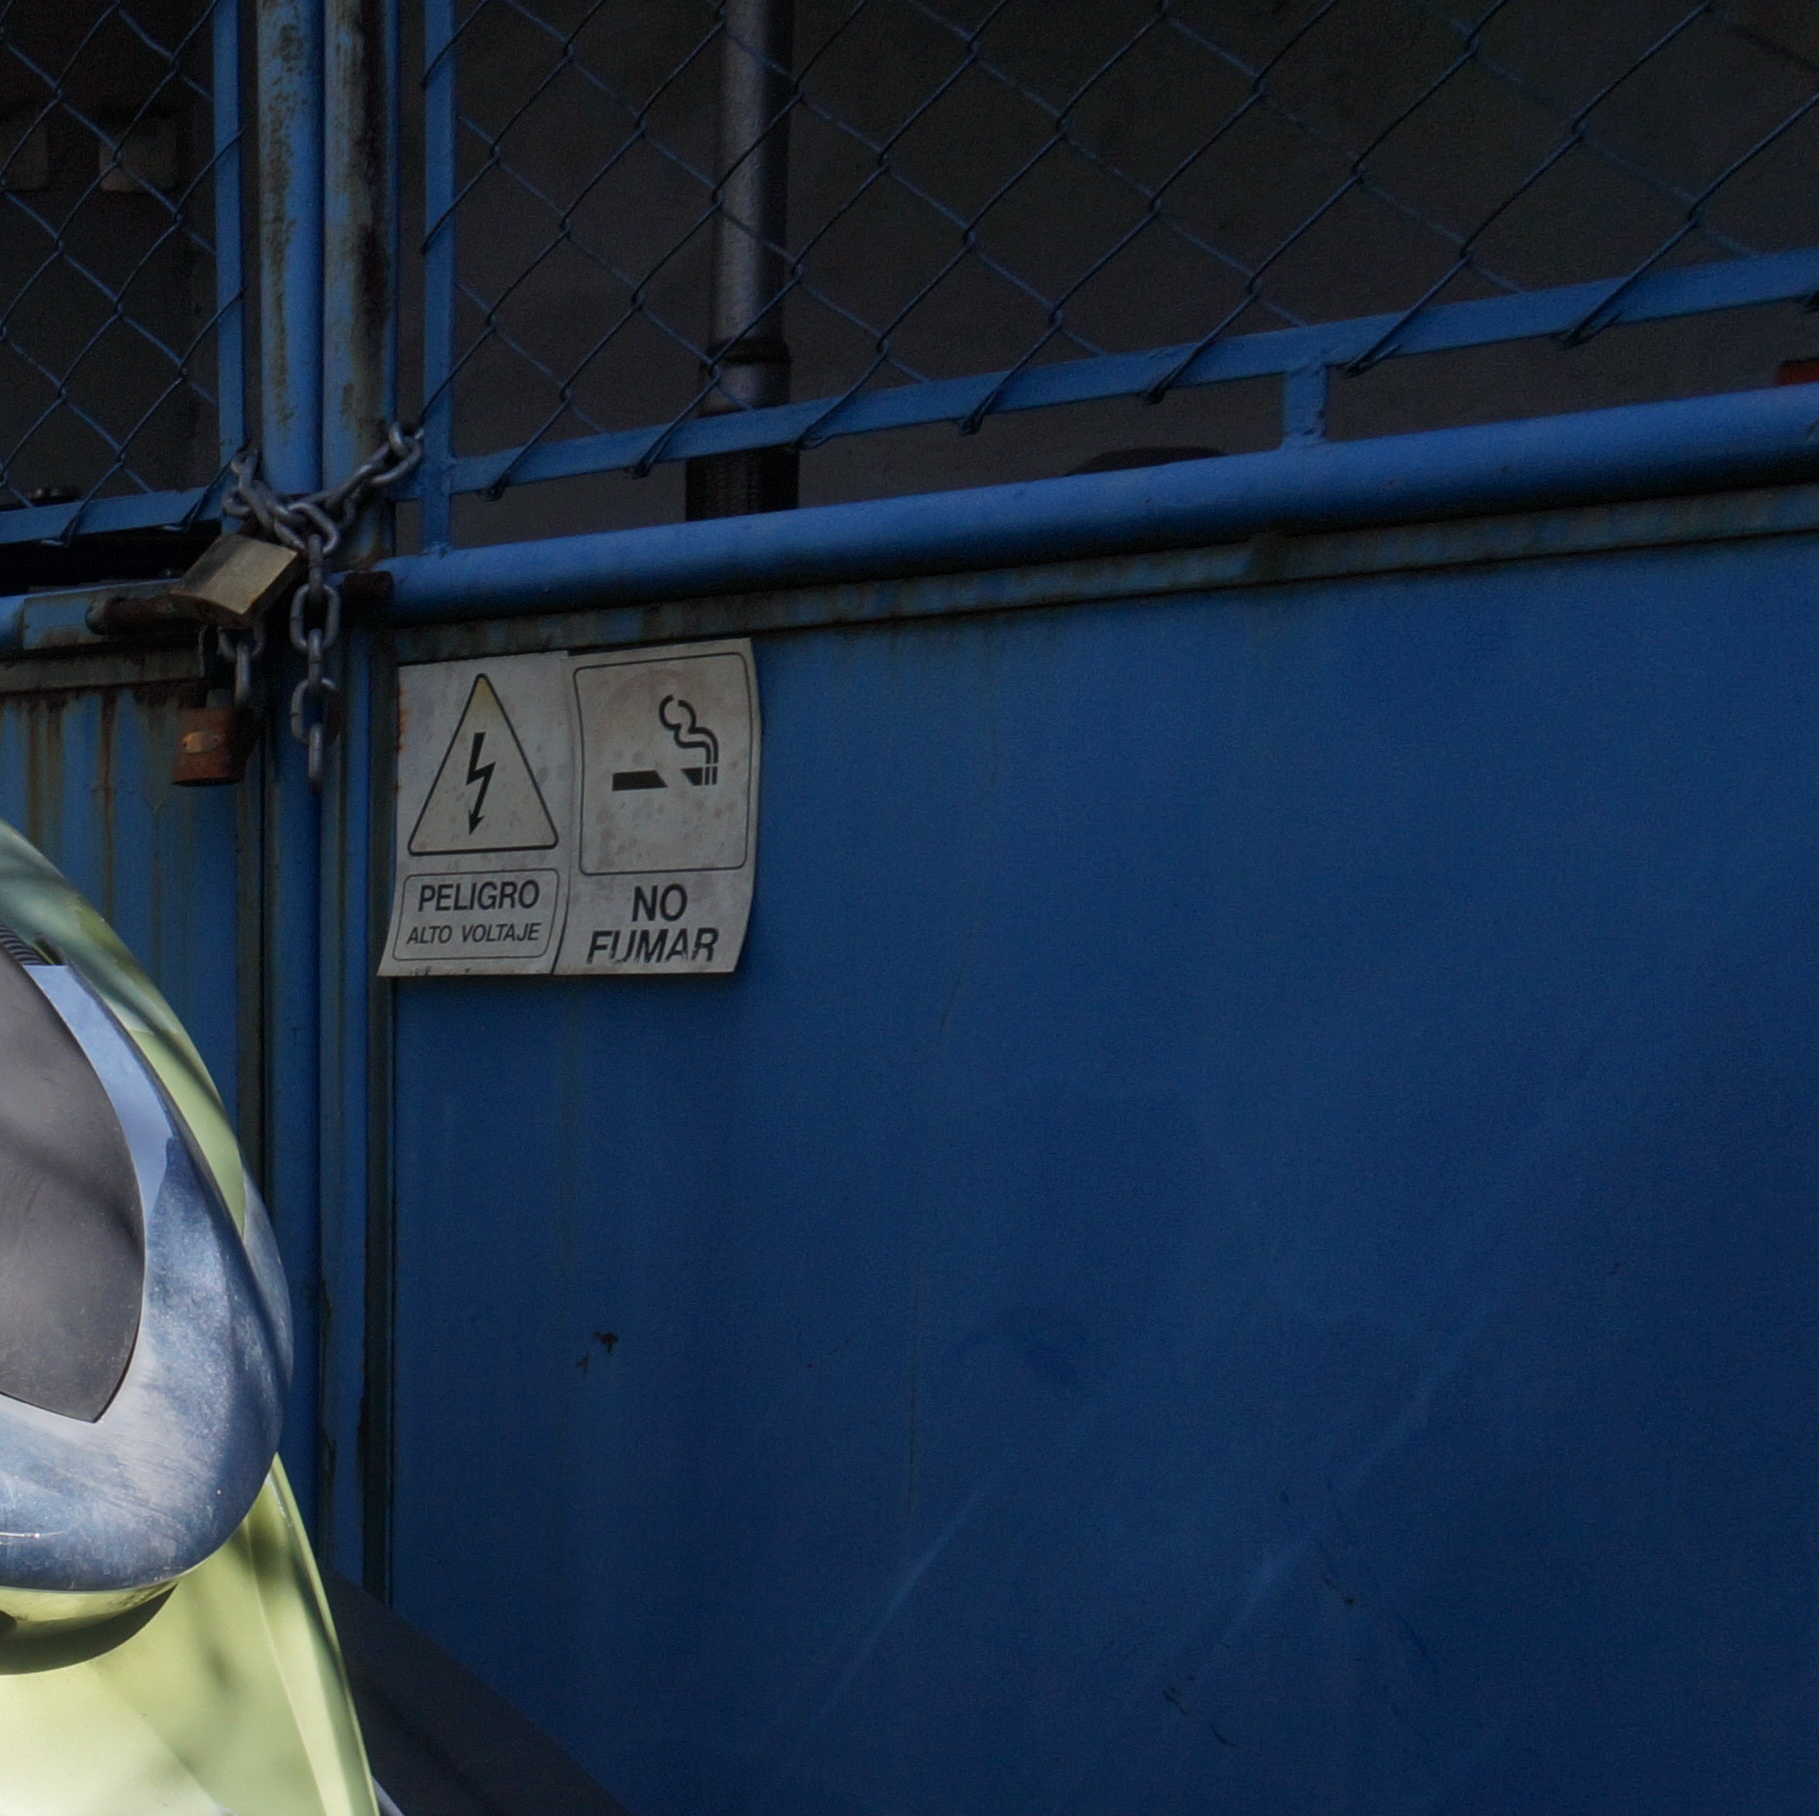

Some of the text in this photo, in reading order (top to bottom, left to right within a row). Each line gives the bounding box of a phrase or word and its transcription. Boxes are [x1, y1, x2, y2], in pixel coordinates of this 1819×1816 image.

[418, 879, 540, 912] PELIGRO
[632, 884, 688, 922] NO
[406, 922, 542, 944] ALTO VOLTAJE
[586, 927, 720, 965] FUMAR
